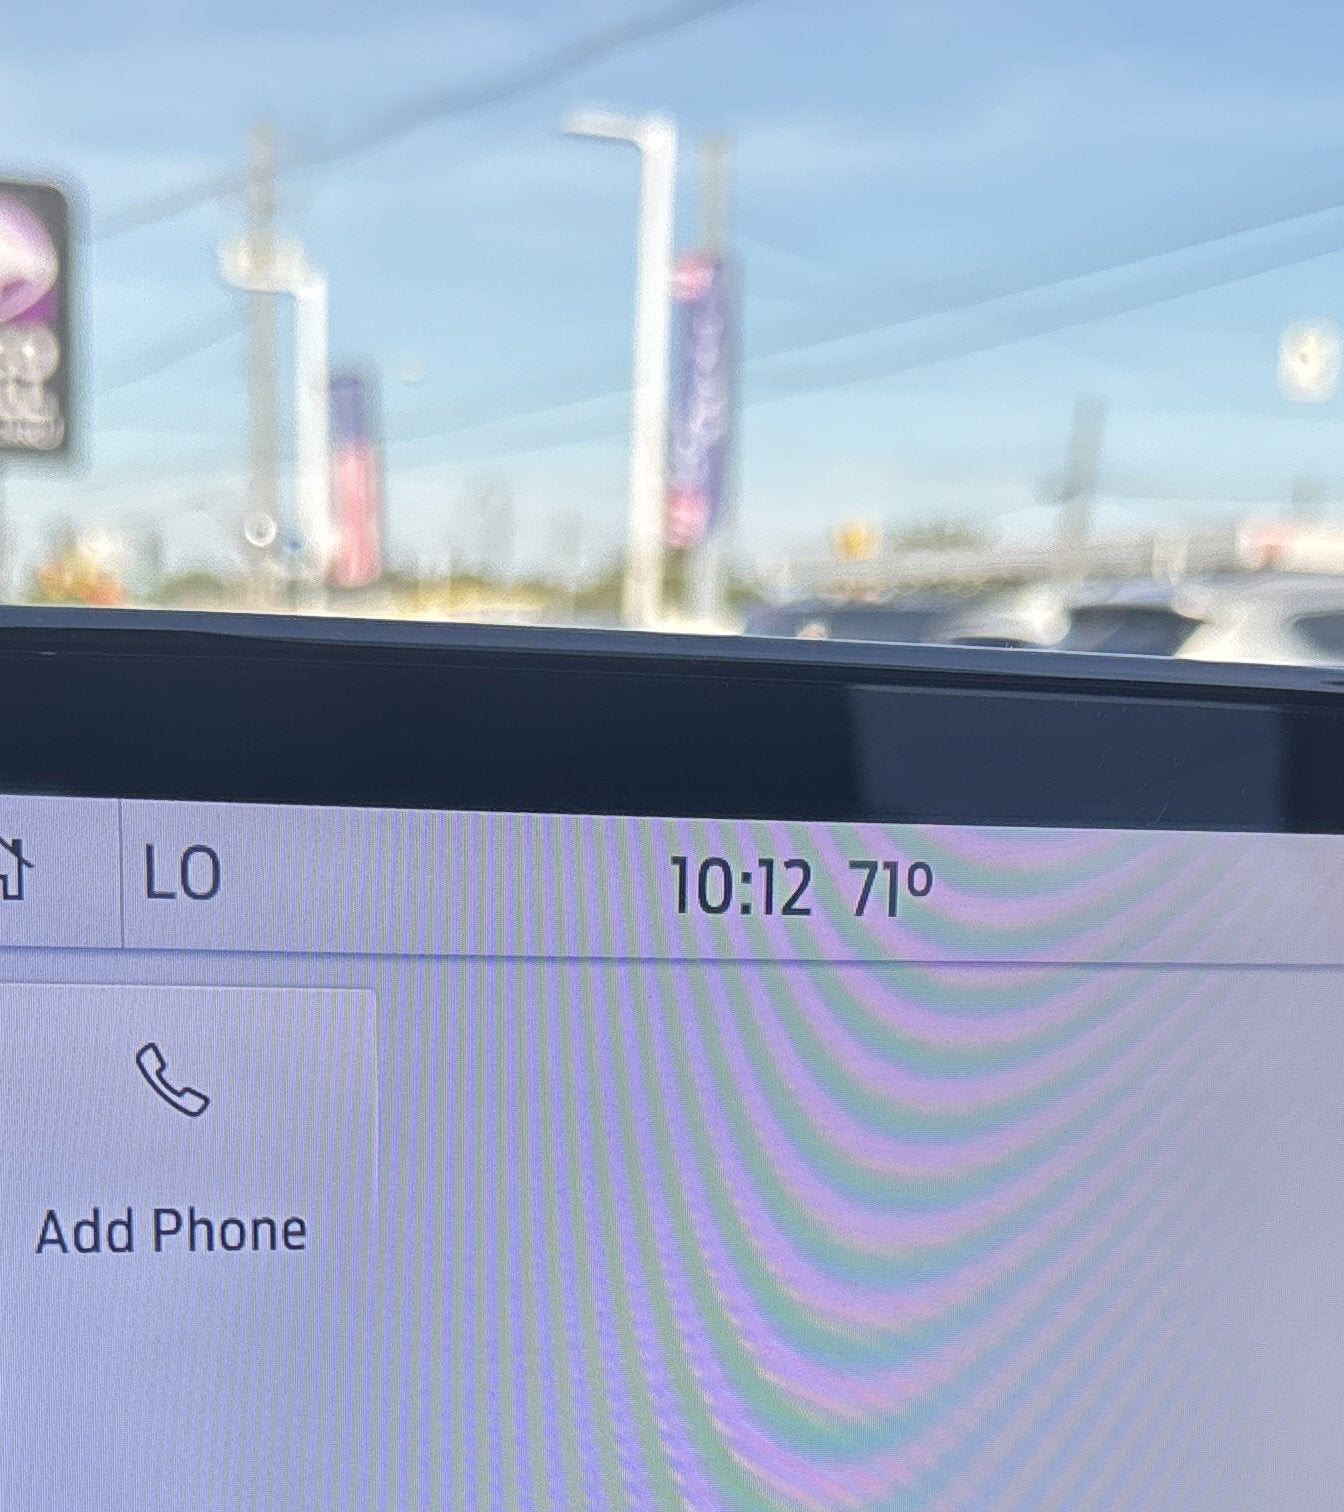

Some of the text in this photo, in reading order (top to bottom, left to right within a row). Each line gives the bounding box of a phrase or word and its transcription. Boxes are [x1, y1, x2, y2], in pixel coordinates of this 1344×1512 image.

[144, 842, 221, 900] LO
[670, 855, 812, 917] 10:12
[36, 1205, 308, 1254] Add Phone
